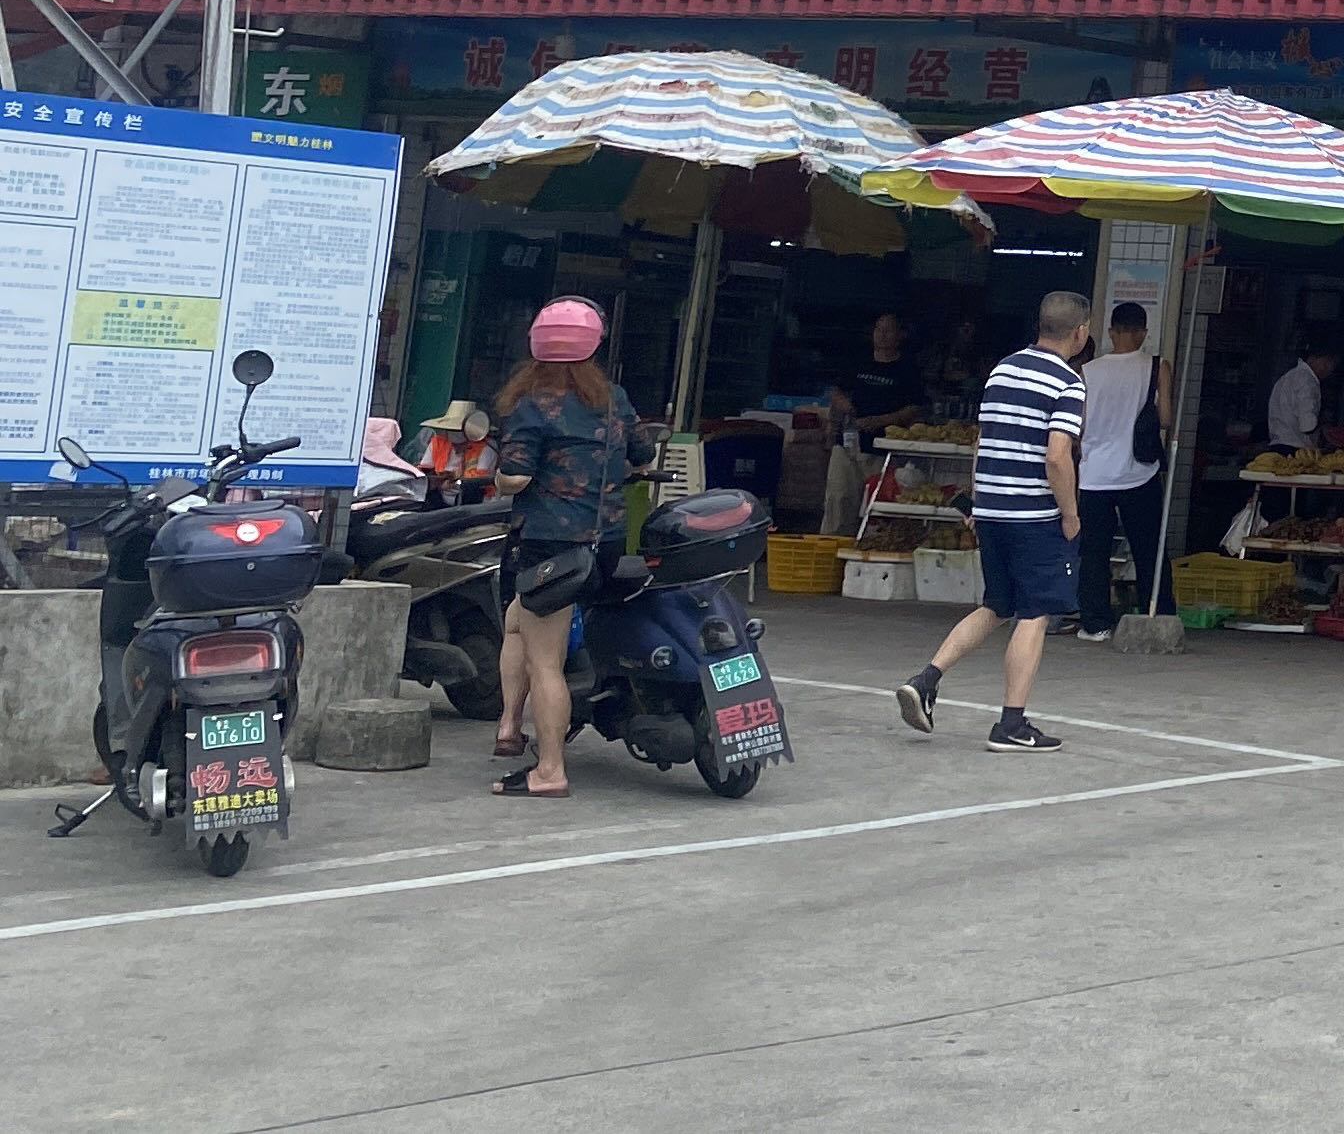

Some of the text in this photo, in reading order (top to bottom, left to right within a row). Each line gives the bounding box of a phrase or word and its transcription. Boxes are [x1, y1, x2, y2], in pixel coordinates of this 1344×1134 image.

[259, 66, 311, 116] 东
[3, 101, 143, 132] 安全宣传栏
[148, 467, 284, 482] 桂林市市场理局制
[717, 667, 755, 688] FY629
[207, 727, 260, 746] QT610
[190, 756, 278, 797] 畅远
